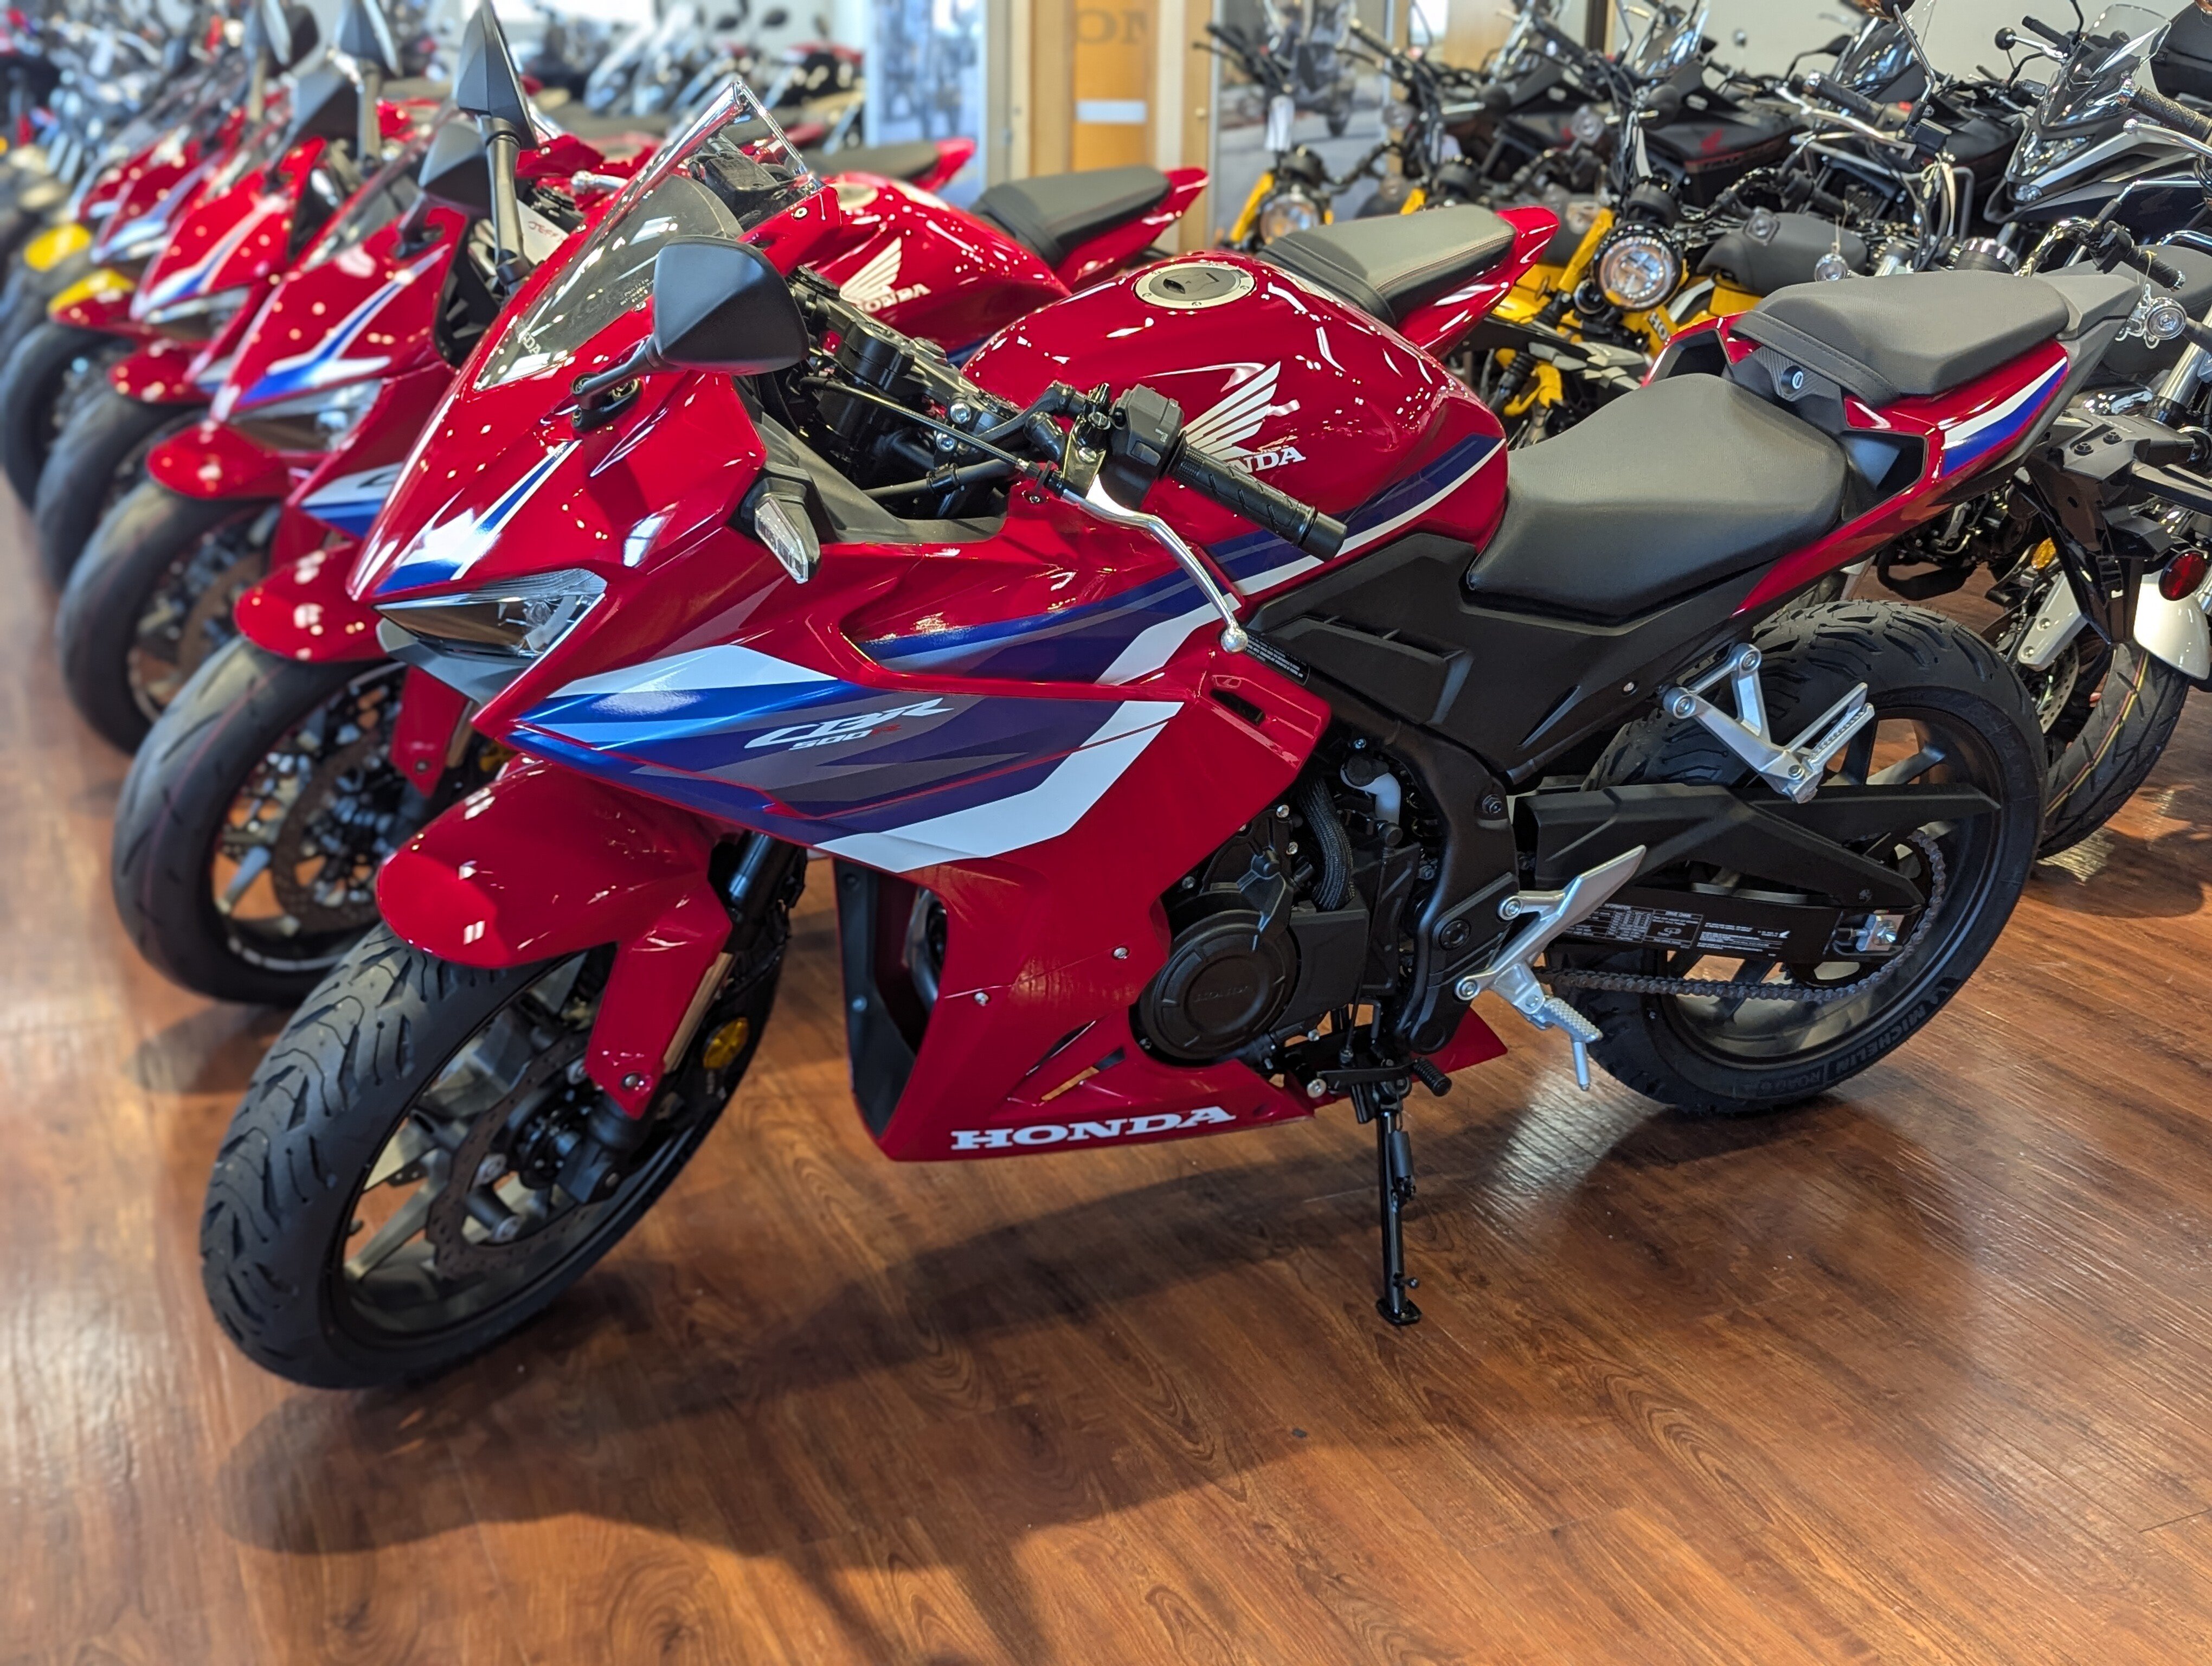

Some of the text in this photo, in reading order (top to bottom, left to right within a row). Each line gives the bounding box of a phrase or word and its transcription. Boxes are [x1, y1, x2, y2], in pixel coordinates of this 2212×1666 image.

[857, 283, 932, 313] ONDA
[1649, 311, 1668, 341] HO
[1227, 446, 1307, 473] NDA
[744, 697, 954, 749] CBR
[788, 723, 902, 751] 500R
[1835, 1004, 1927, 1074] MICHELIN
[951, 1106, 1237, 1150] HONDA
